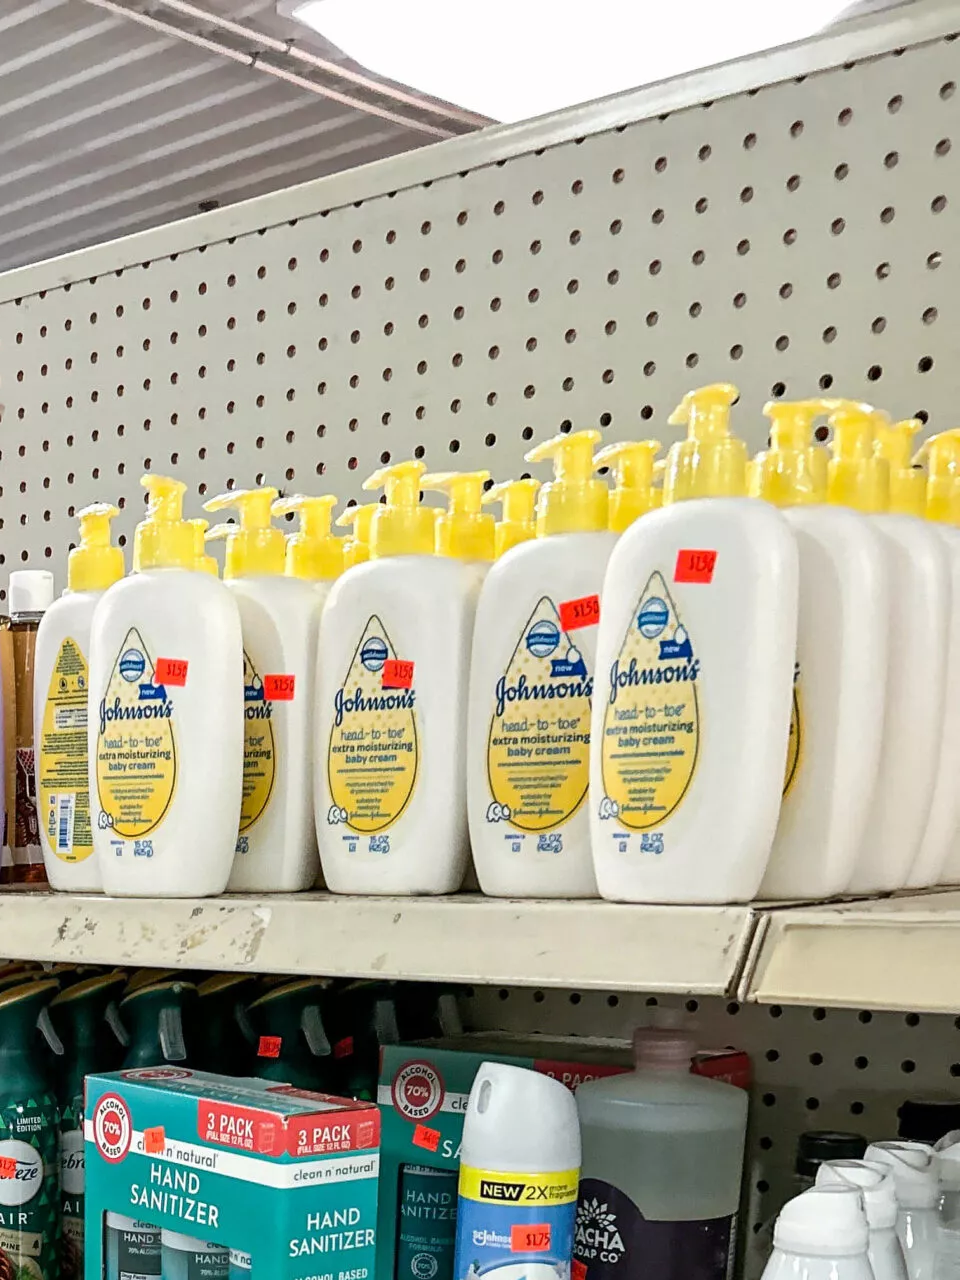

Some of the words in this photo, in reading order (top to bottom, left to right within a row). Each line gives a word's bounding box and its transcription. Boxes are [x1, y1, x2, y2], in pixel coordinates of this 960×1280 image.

[555, 664, 572, 672] new
[610, 658, 700, 704] Johnson's
[142, 688, 155, 696] new
[496, 675, 593, 716] Johnson's
[334, 688, 416, 726] Johnson's
[100, 697, 173, 734] Johnson's
[606, 724, 628, 736] extra
[630, 721, 693, 734] moisturizing
[493, 736, 518, 745] extra
[520, 734, 590, 745] moisturizing
[618, 737, 641, 748] baby
[643, 736, 675, 745] cream
[99, 751, 116, 760] extra
[118, 750, 171, 760] moisturizing
[332, 743, 354, 753] extra
[357, 742, 413, 752] moisturizing
[507, 747, 533, 758] baby
[535, 746, 570, 756] cream
[345, 755, 367, 764] baby
[369, 754, 397, 762] cream
[109, 762, 126, 772] baby
[128, 762, 155, 770] cream
[400, 1066, 436, 1084] ALCOHOL
[407, 1085, 428, 1097] 70%
[99, 1099, 126, 1121] ALCOHOL
[403, 1105, 429, 1118] BASED
[17, 1117, 40, 1125] LIMITED
[17, 1124, 41, 1132] EDITION
[104, 1121, 121, 1135] 70%
[207, 1113, 215, 1129] 3
[220, 1115, 253, 1138] PACK
[298, 1130, 307, 1146] 3
[313, 1125, 351, 1144] PACK
[101, 1142, 122, 1156] BASED
[173, 1145, 216, 1168] natural
[150, 1163, 200, 1195] HAND
[294, 1167, 322, 1181] clean
[336, 1162, 374, 1177] natural
[407, 1189, 451, 1204] HAND
[483, 1185, 521, 1199] NEW
[526, 1186, 548, 1200] 2X
[130, 1184, 219, 1229] SANITIZER
[401, 1205, 456, 1220] ANITIZE
[307, 1208, 360, 1232] HAND
[124, 1233, 154, 1244] HAND
[289, 1229, 375, 1258] SANITIZER
[1, 1242, 20, 1251] PINE
